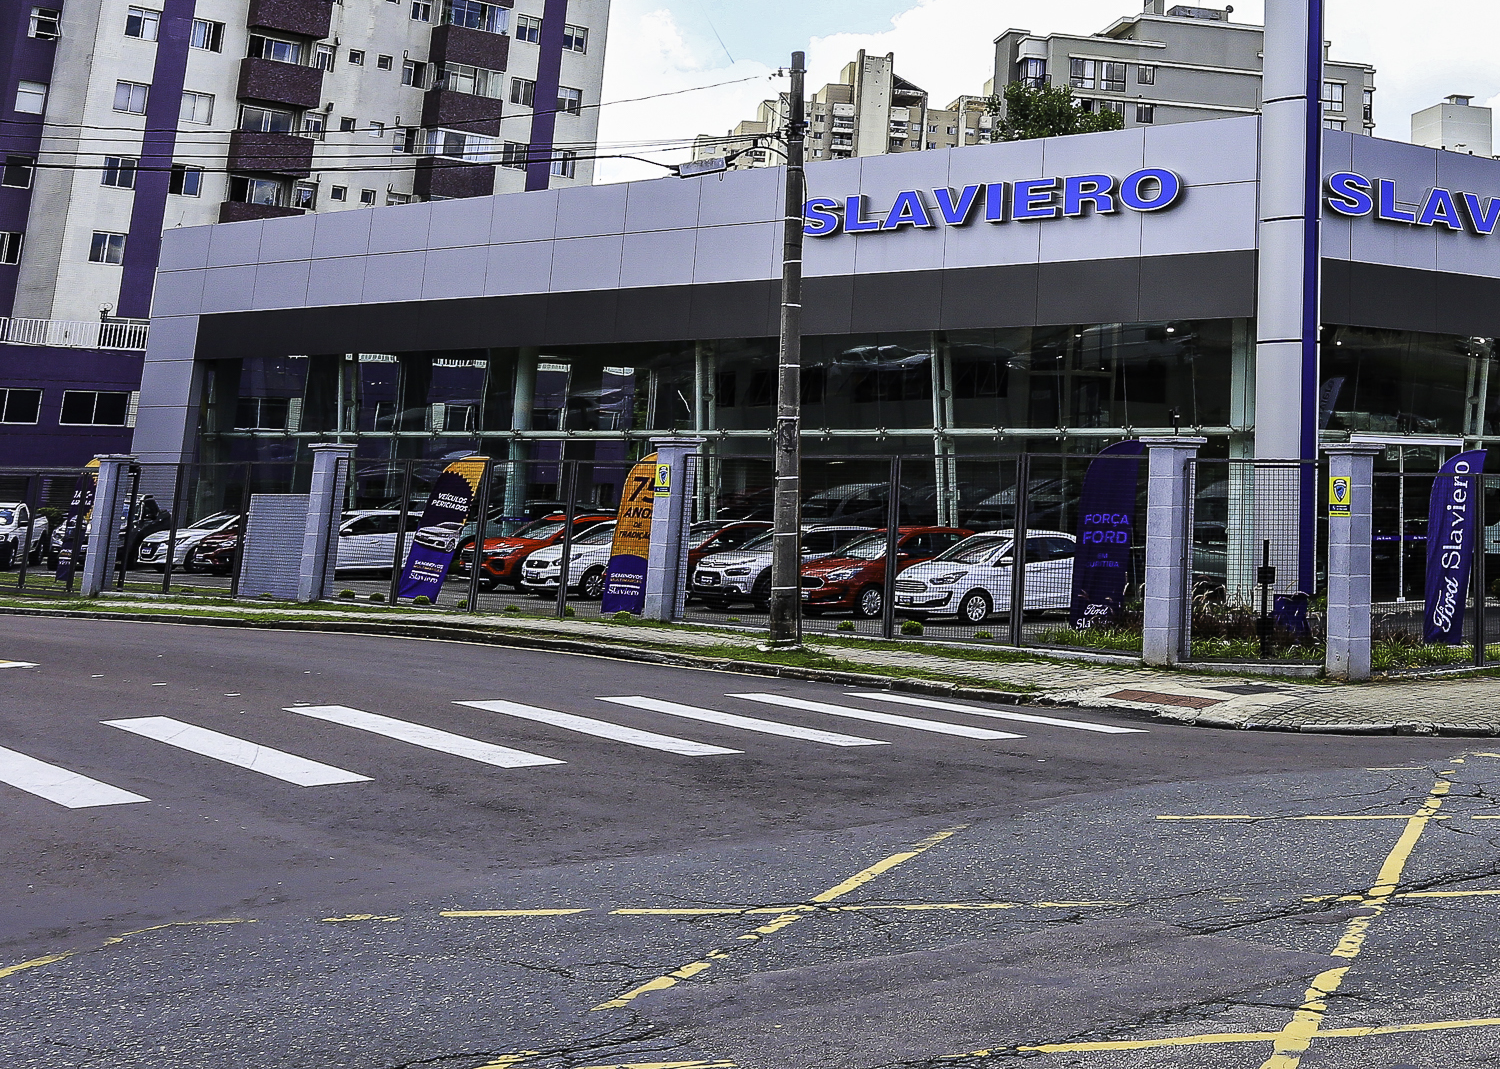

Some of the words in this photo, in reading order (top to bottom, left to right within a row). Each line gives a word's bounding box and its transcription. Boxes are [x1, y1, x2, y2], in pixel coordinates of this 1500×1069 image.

[802, 167, 1182, 237] SLAVIERO
[438, 492, 468, 504] VEÍCULOS
[431, 499, 469, 512] PERICIADOS
[623, 507, 652, 519] ANO
[1084, 513, 1129, 527] FORÇA
[1441, 460, 1470, 569] Slaviero
[1082, 530, 1128, 545] FORD
[1083, 603, 1109, 616] Ford
[1433, 576, 1459, 633] Ford
